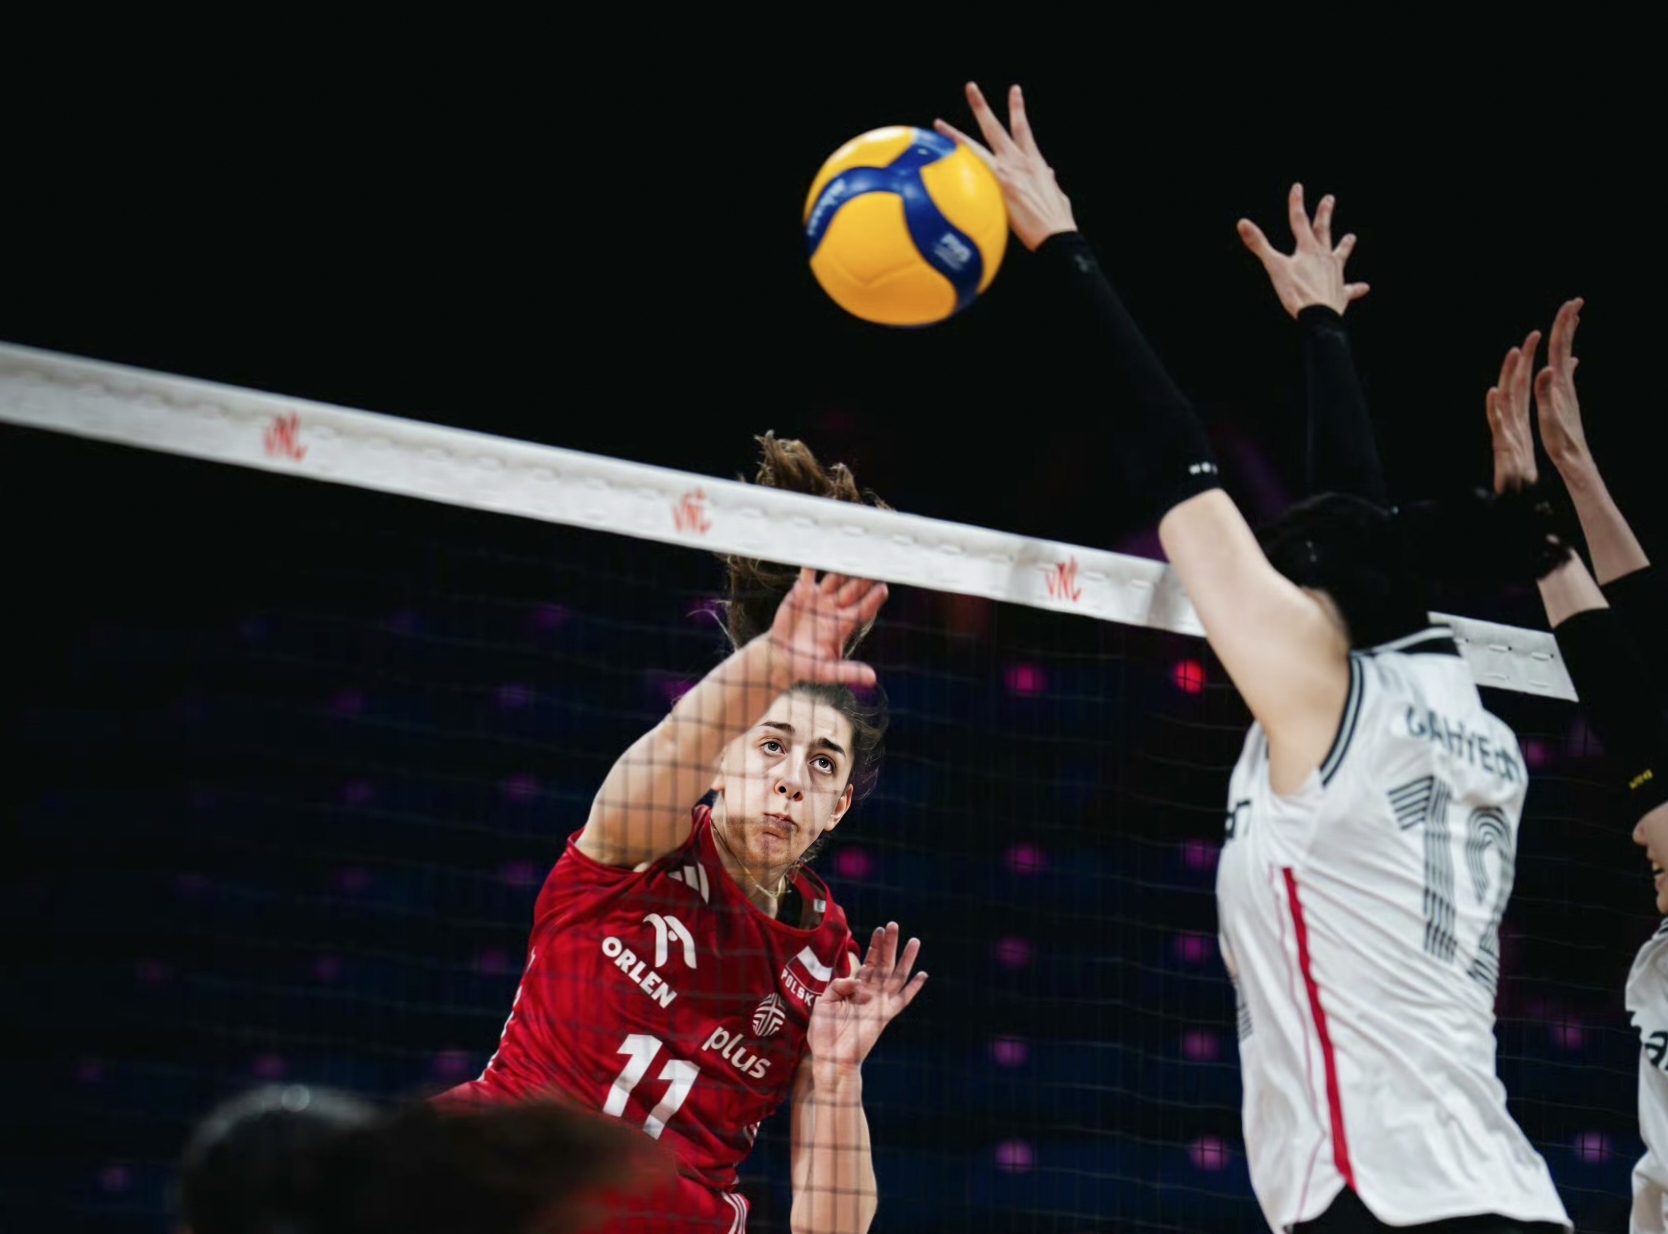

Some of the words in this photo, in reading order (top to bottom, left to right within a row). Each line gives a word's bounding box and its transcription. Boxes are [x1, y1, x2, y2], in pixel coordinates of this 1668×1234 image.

[601, 936, 678, 1009] ORLEN
[780, 967, 820, 1007] POLSK
[701, 1026, 772, 1079] plus
[602, 1033, 700, 1140] 11
